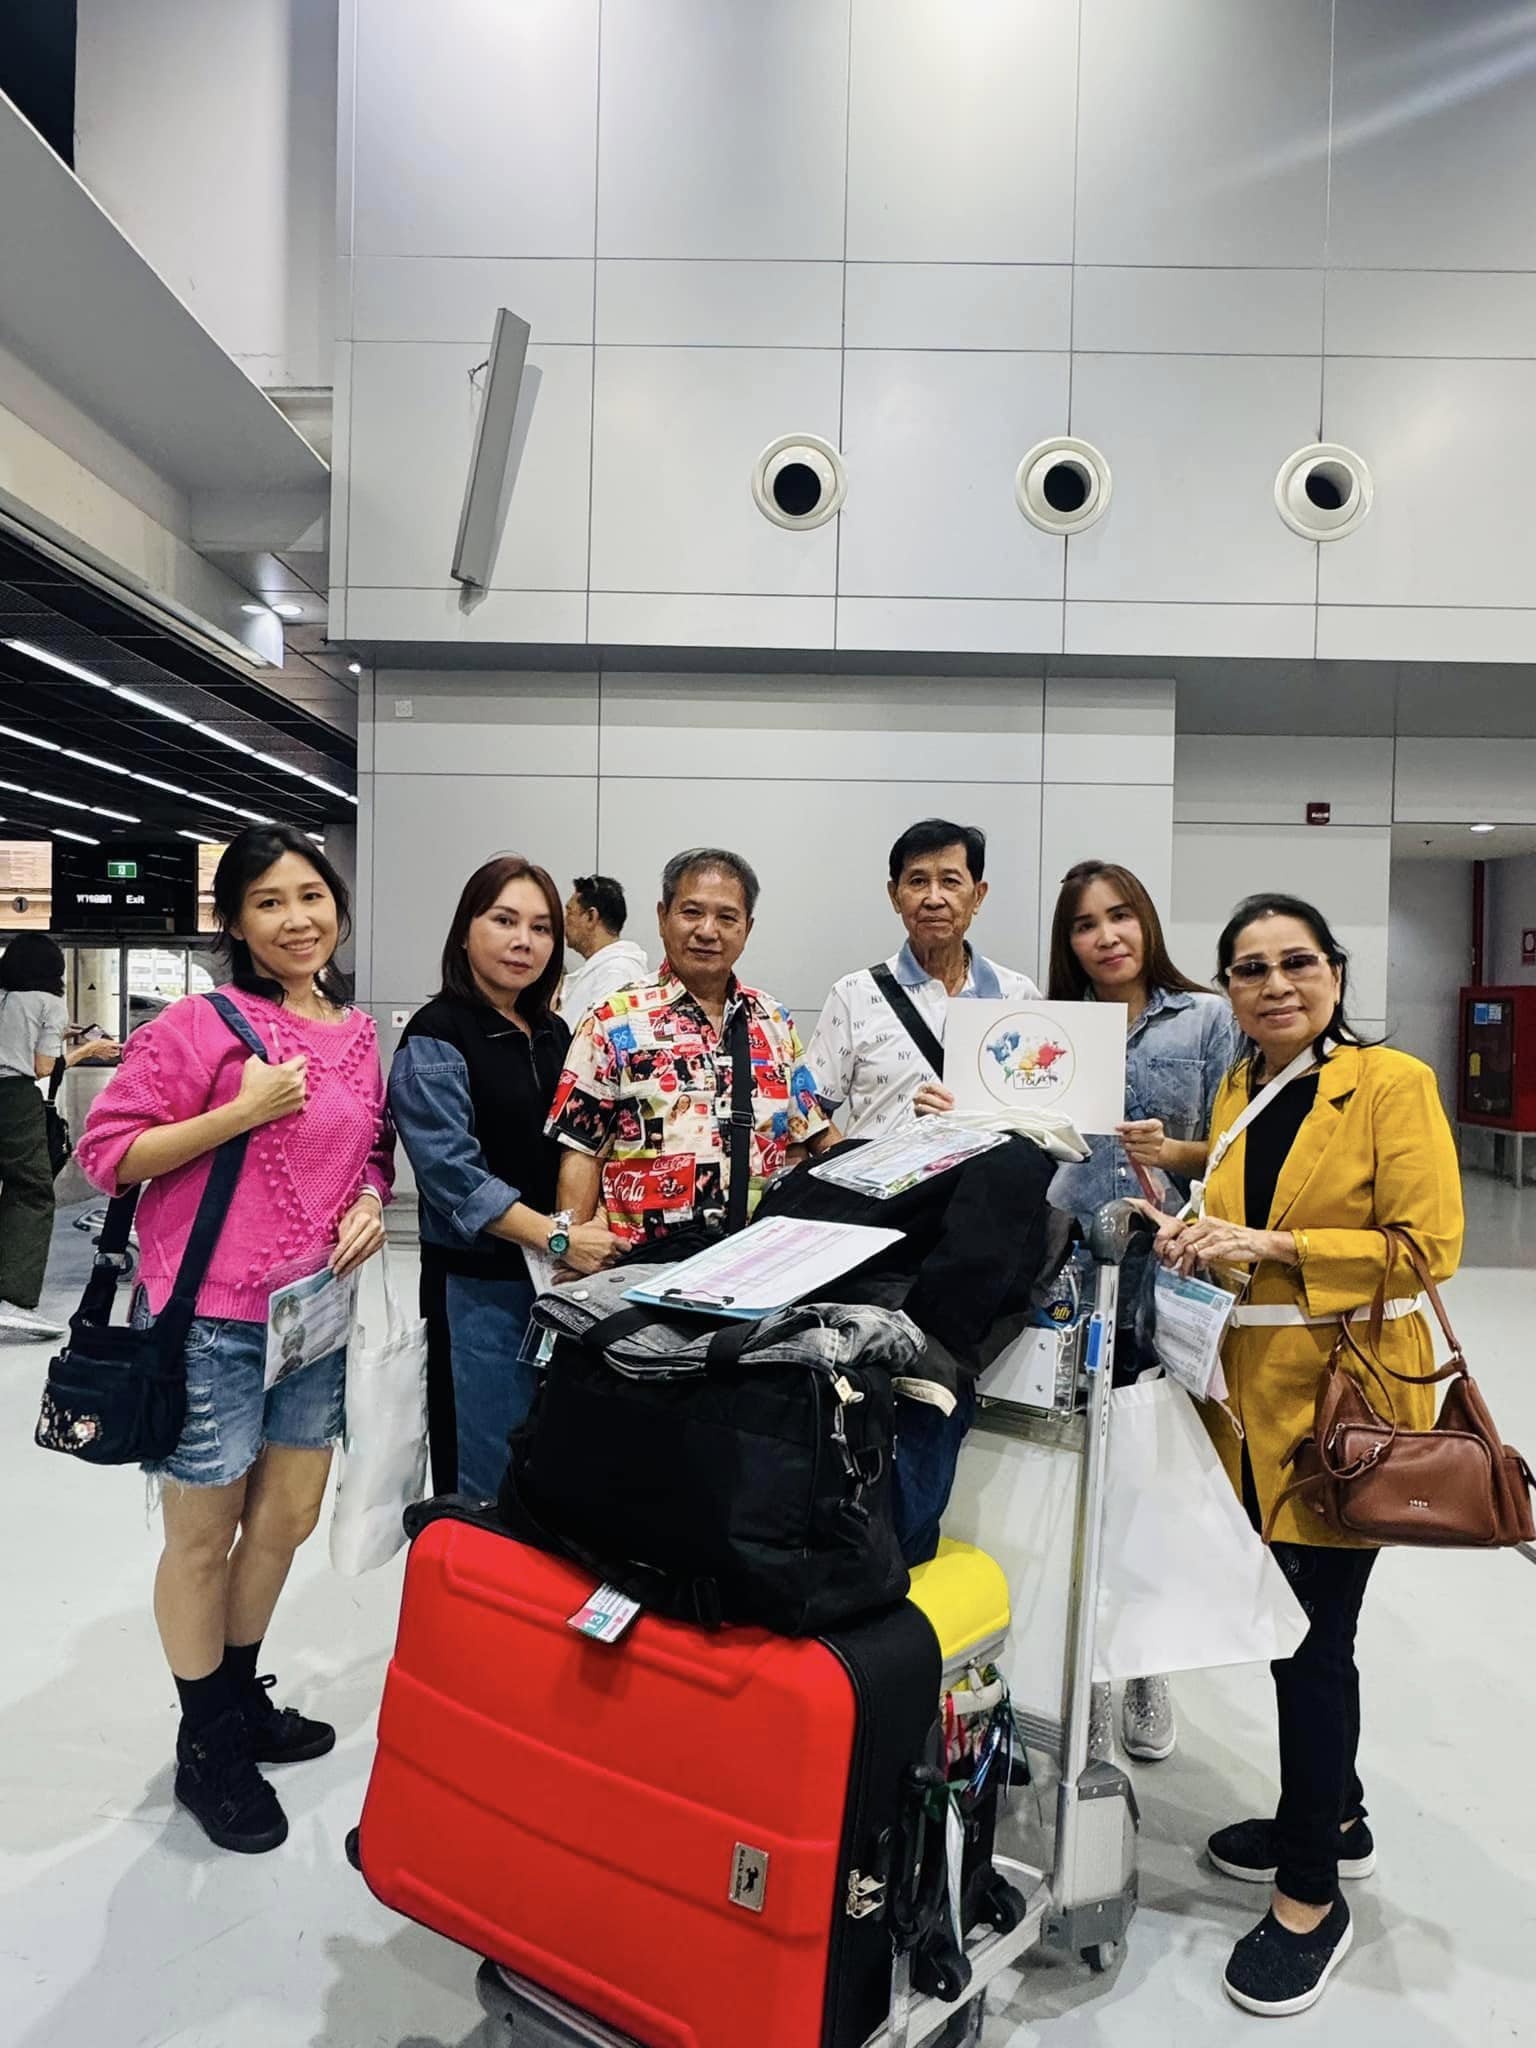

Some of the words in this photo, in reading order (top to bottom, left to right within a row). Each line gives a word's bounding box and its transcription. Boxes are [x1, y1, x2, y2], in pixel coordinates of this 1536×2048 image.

[126, 894, 145, 904] Exit
[853, 1020, 865, 1030] NY
[897, 1050, 911, 1061] NY
[876, 1074, 889, 1084] NY
[921, 1072, 934, 1082] NY
[823, 1086, 835, 1097] NY
